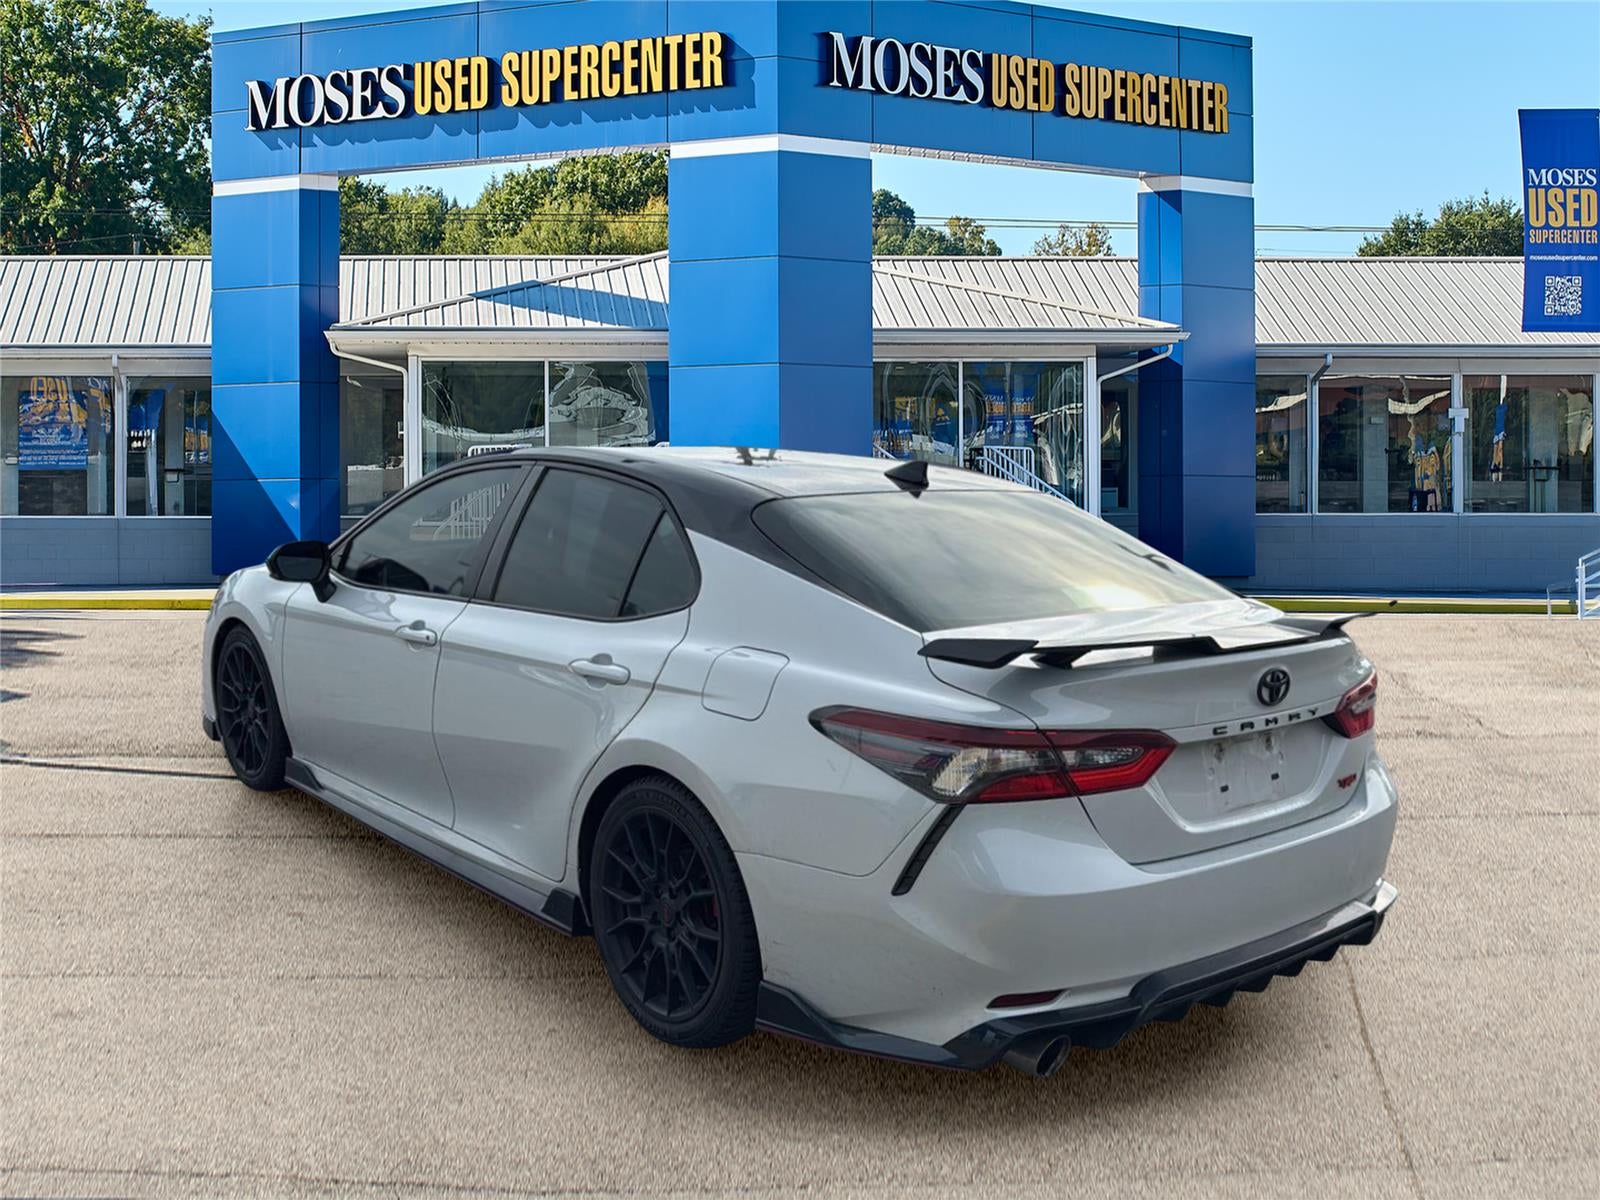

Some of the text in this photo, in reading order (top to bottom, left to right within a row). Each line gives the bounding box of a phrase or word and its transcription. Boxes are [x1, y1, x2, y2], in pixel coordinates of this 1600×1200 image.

[245, 31, 723, 132] MOSES USED SUPERCENTER
[828, 31, 1229, 133] MOSES USED SUPERCENTER
[1528, 168, 1597, 186] MOSES
[1529, 188, 1598, 227] USED
[1530, 229, 1598, 244] SUPERCENTER
[1212, 707, 1319, 736] CAMRY
